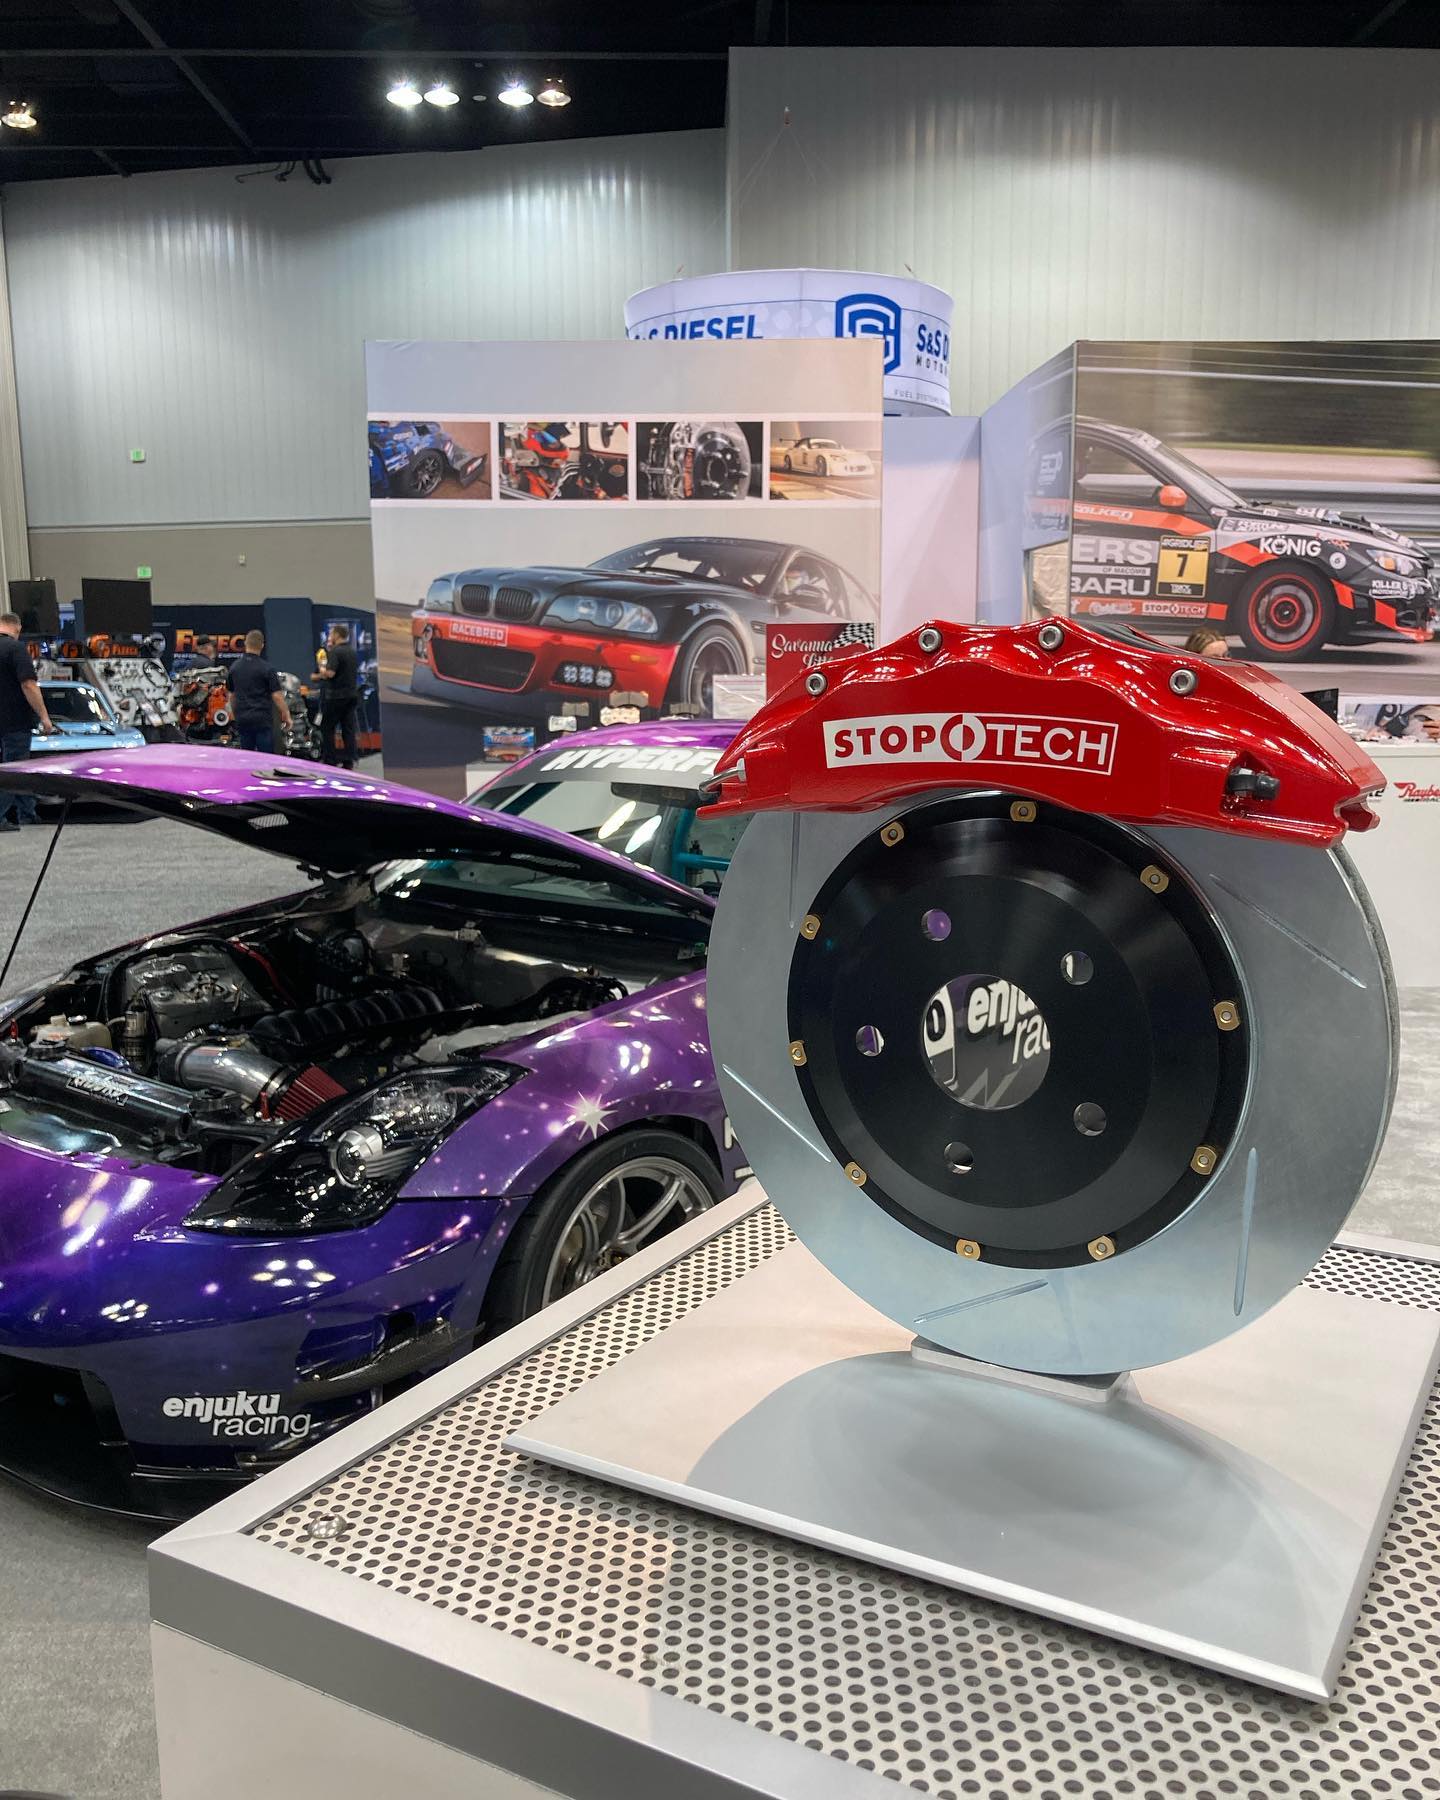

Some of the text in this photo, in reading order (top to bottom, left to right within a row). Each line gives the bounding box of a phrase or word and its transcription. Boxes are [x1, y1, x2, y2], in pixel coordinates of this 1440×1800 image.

[916, 323, 942, 358] S&S
[1078, 540, 1153, 566] ERS
[1259, 535, 1321, 557] KÖNIG
[1177, 553, 1188, 578] 7
[162, 1390, 281, 1423] enjuku
[212, 1413, 311, 1438] racing
